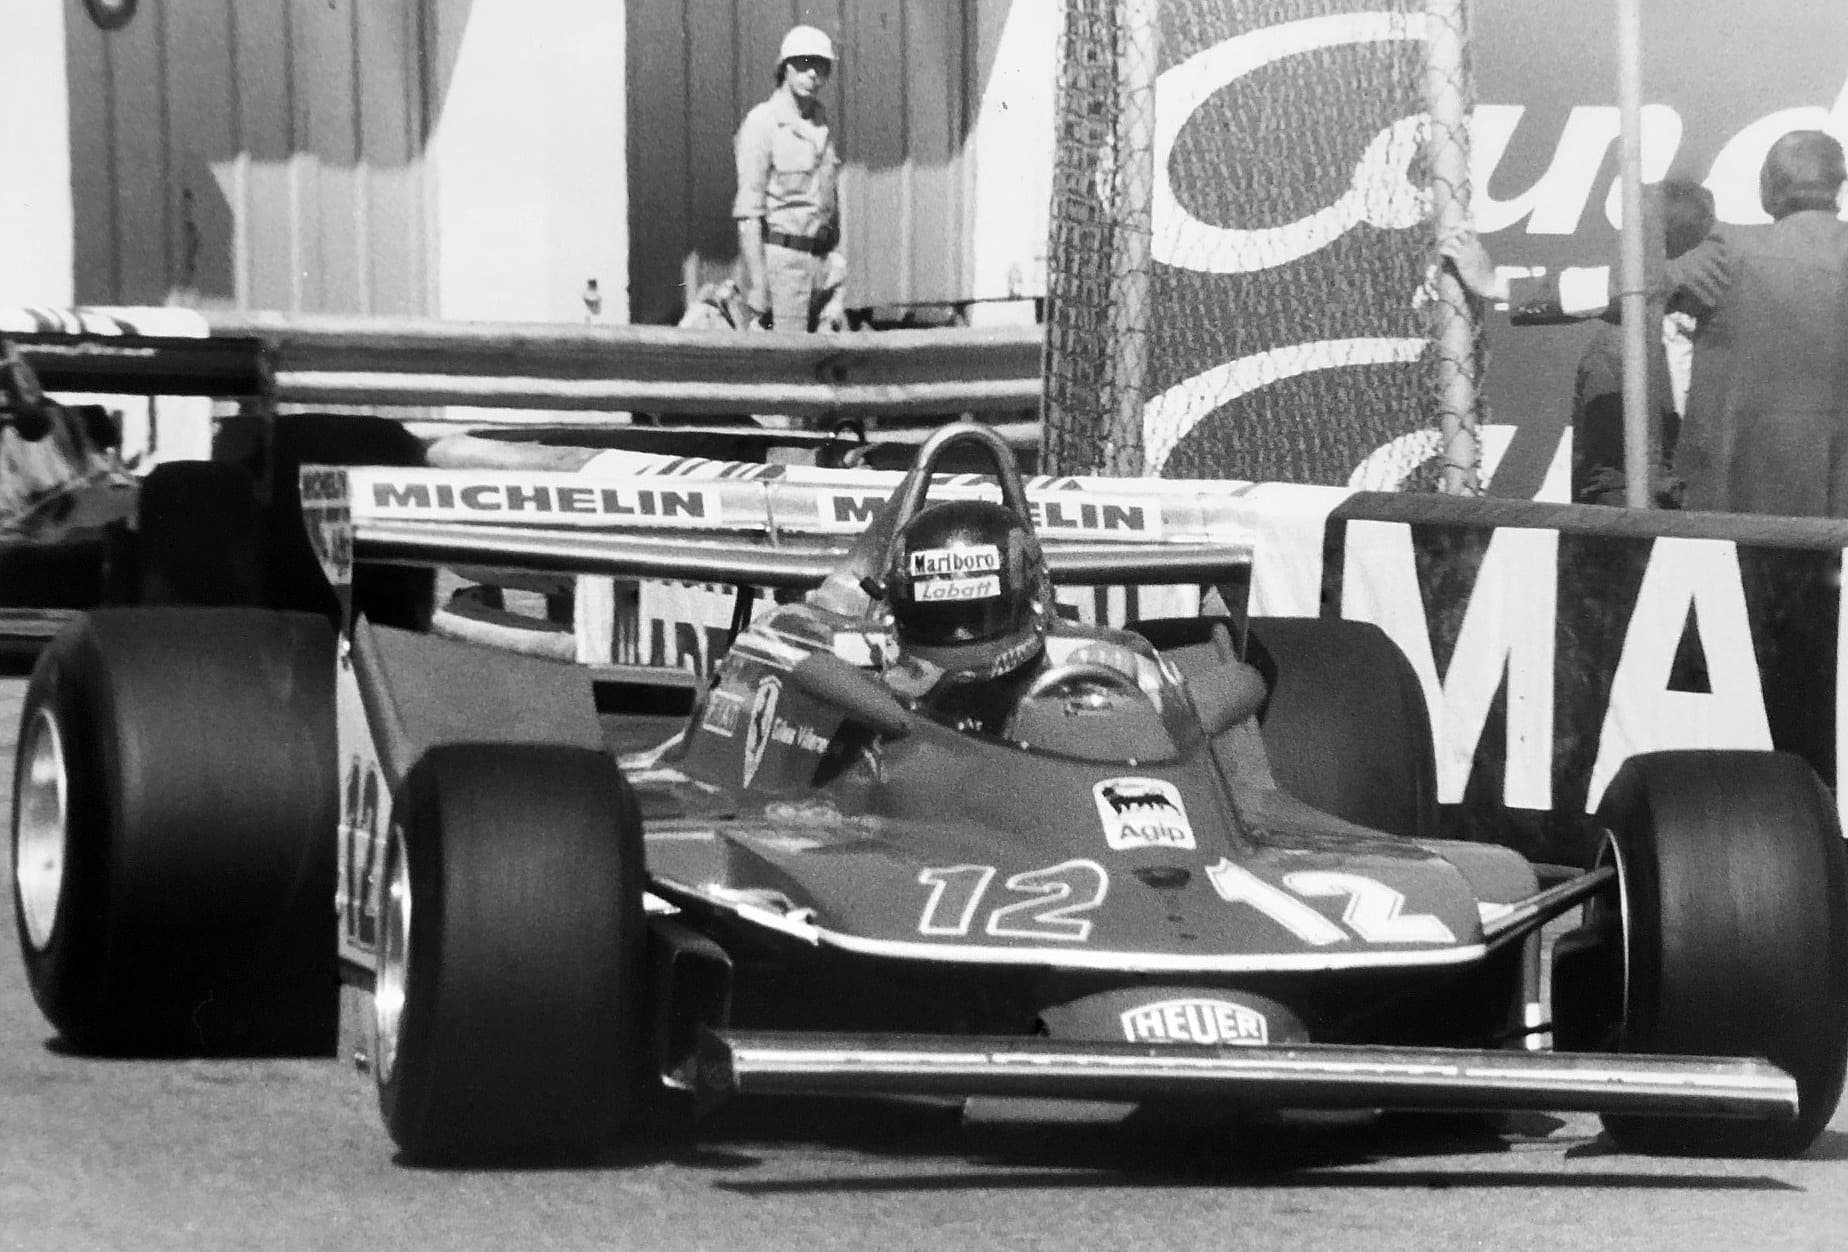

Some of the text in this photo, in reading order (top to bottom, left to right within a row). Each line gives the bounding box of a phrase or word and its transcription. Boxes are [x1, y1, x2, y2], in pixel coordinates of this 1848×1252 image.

[373, 483, 705, 517] MICHELIN
[833, 496, 1145, 530] MLIN
[914, 553, 995, 573] Marlboro
[922, 582, 992, 599] Labatt
[1120, 821, 1185, 842] Agip
[918, 859, 1109, 942] 12
[1206, 857, 1457, 946] 12
[1136, 1003, 1260, 1044] HEUER
